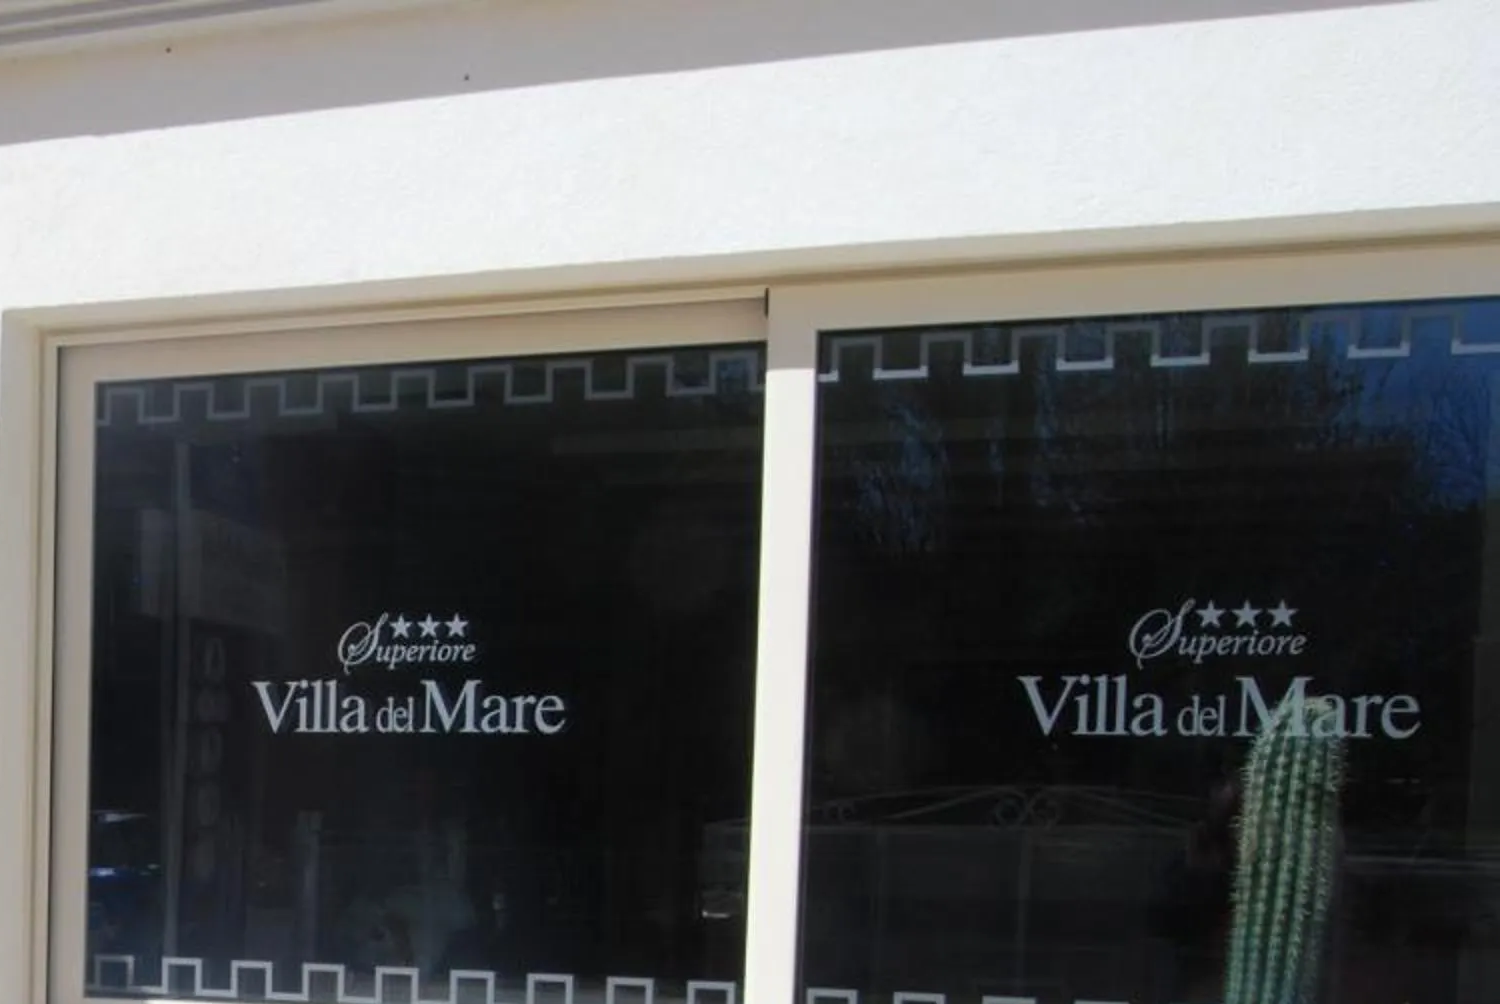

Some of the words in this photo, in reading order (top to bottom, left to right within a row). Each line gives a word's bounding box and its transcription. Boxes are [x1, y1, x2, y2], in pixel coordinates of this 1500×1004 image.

[337, 612, 477, 675] Superiore
[1130, 598, 1307, 670] Superiore
[252, 679, 367, 734] Villa
[375, 697, 415, 734] del
[420, 679, 566, 734] Mare
[1017, 674, 1168, 737] Villa
[1177, 695, 1225, 737] del
[1233, 676, 1421, 739] Mare
